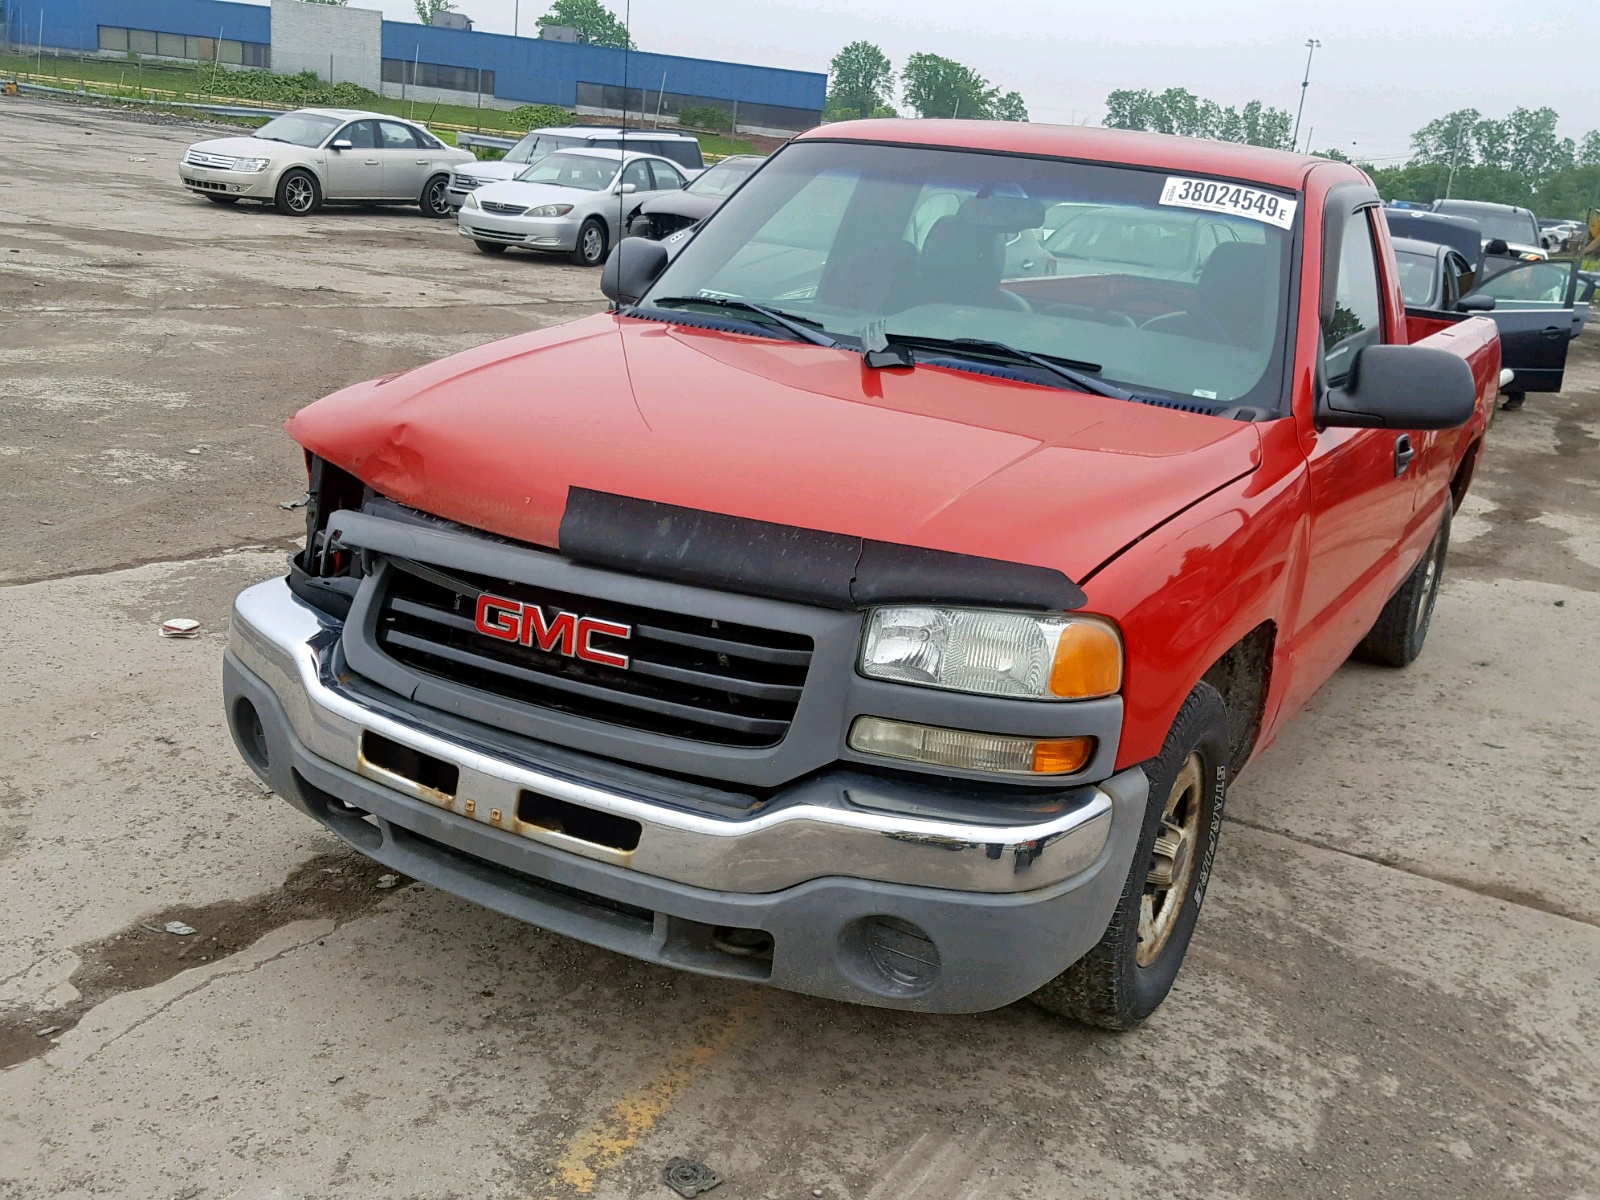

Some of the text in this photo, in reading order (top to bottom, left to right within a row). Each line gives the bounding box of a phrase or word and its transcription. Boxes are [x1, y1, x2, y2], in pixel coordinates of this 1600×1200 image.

[1178, 180, 1279, 217] 38024549
[1278, 208, 1287, 221] E
[475, 592, 632, 670] GMC
[1193, 765, 1226, 909] STARFIRE
